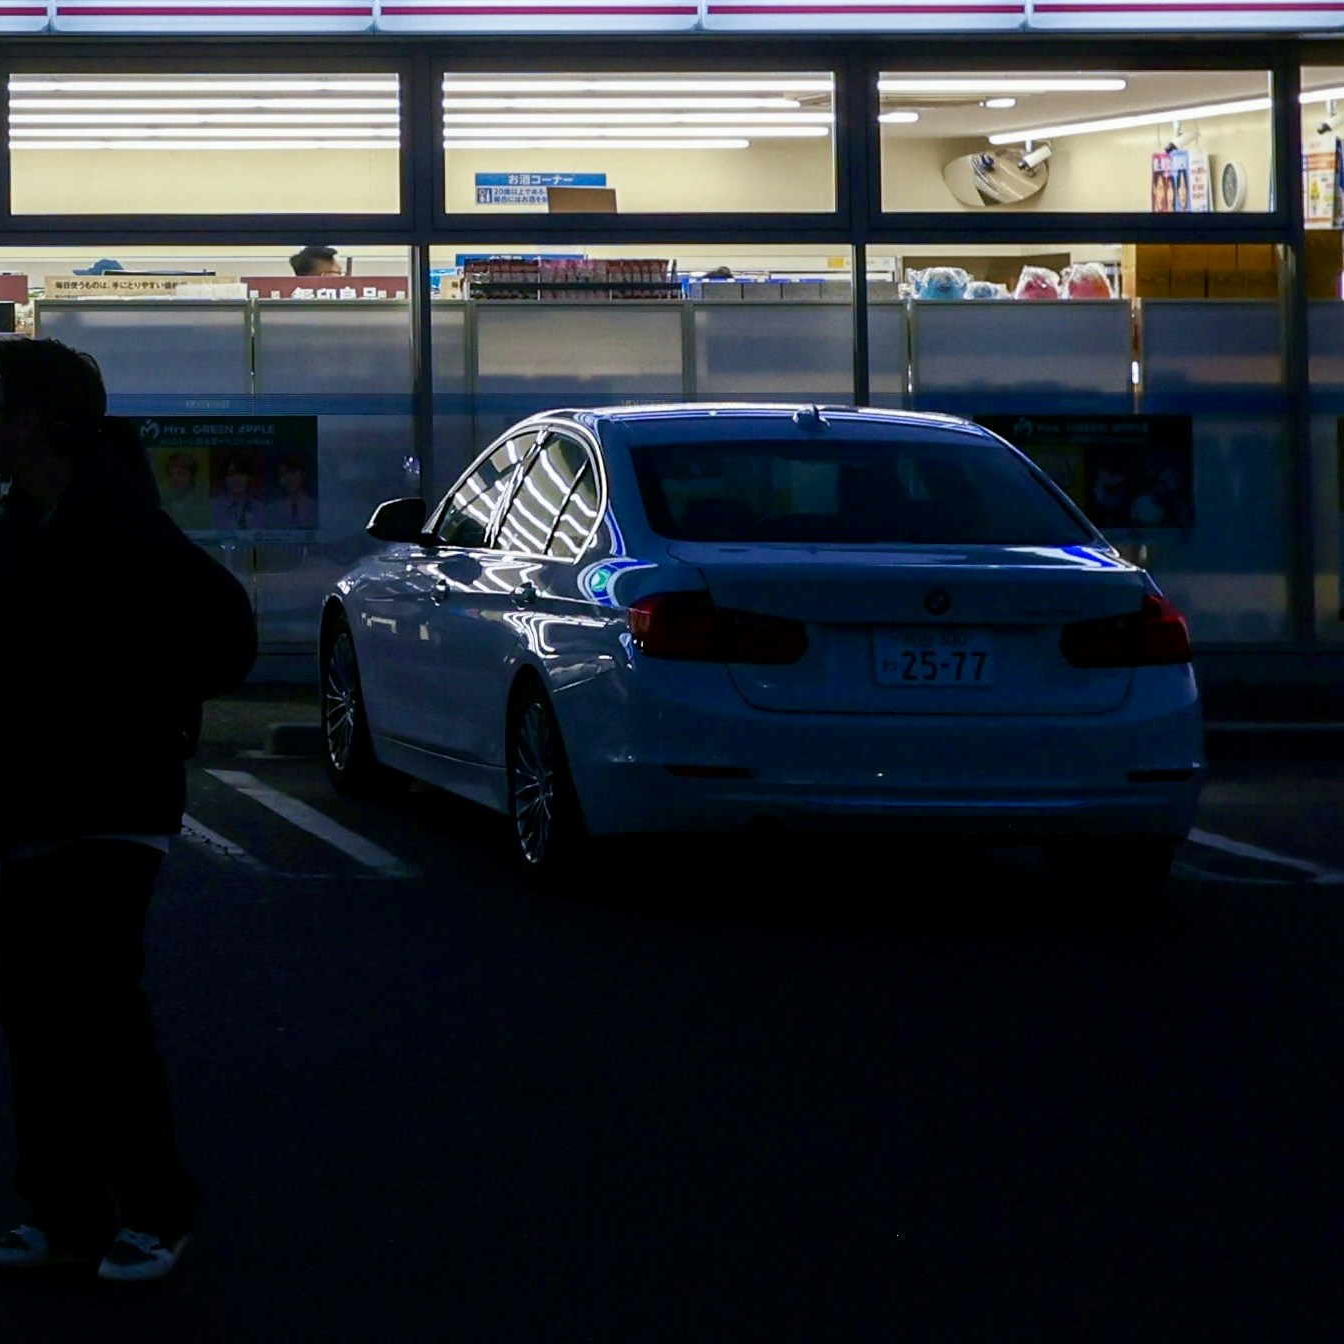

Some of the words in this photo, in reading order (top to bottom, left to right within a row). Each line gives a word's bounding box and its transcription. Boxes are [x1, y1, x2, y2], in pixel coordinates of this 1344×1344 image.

[508, 174, 574, 185] お酒コーナー
[192, 425, 234, 435] GREEN
[235, 424, 276, 434] APPLE
[902, 650, 987, 680] 25-77
